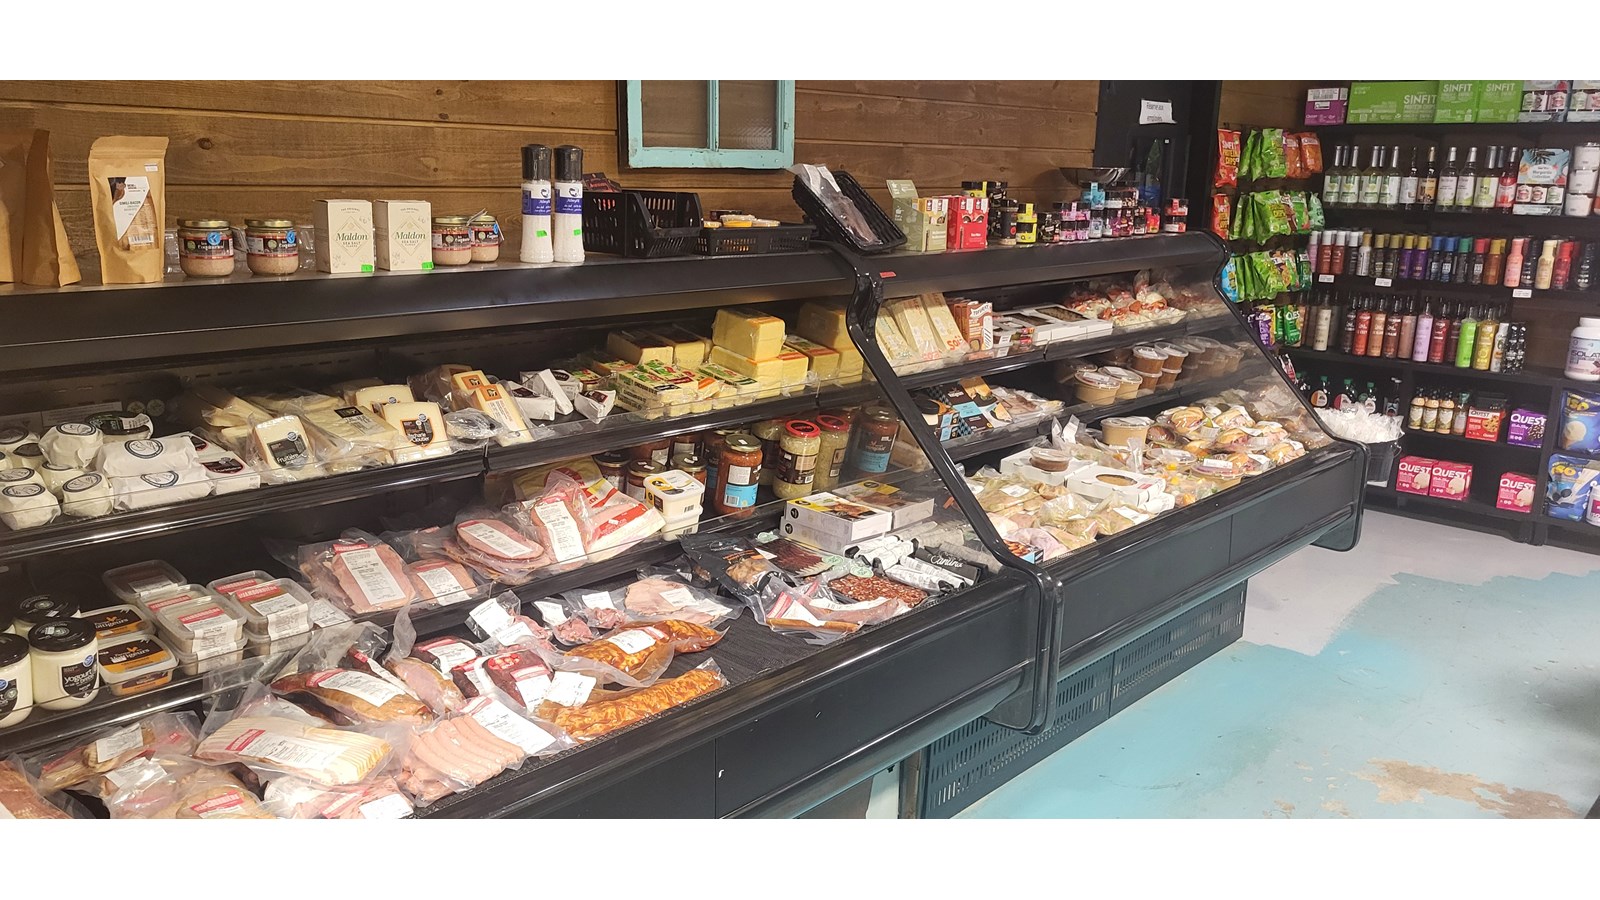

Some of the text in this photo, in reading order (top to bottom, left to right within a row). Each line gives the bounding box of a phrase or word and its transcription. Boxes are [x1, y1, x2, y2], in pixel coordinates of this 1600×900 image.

[1443, 83, 1473, 93] SINFIT
[1486, 83, 1516, 92] SINFIT
[1403, 94, 1437, 104] SINFIT
[336, 232, 368, 241] Maldon
[394, 231, 426, 240] Maldon
[1286, 311, 1300, 321] QUES
[1470, 410, 1490, 418] QUEST
[1510, 413, 1547, 425] QUEST
[1398, 462, 1431, 475] QUEST
[1432, 467, 1467, 479] QUEST
[1500, 478, 1536, 490] QUEST
